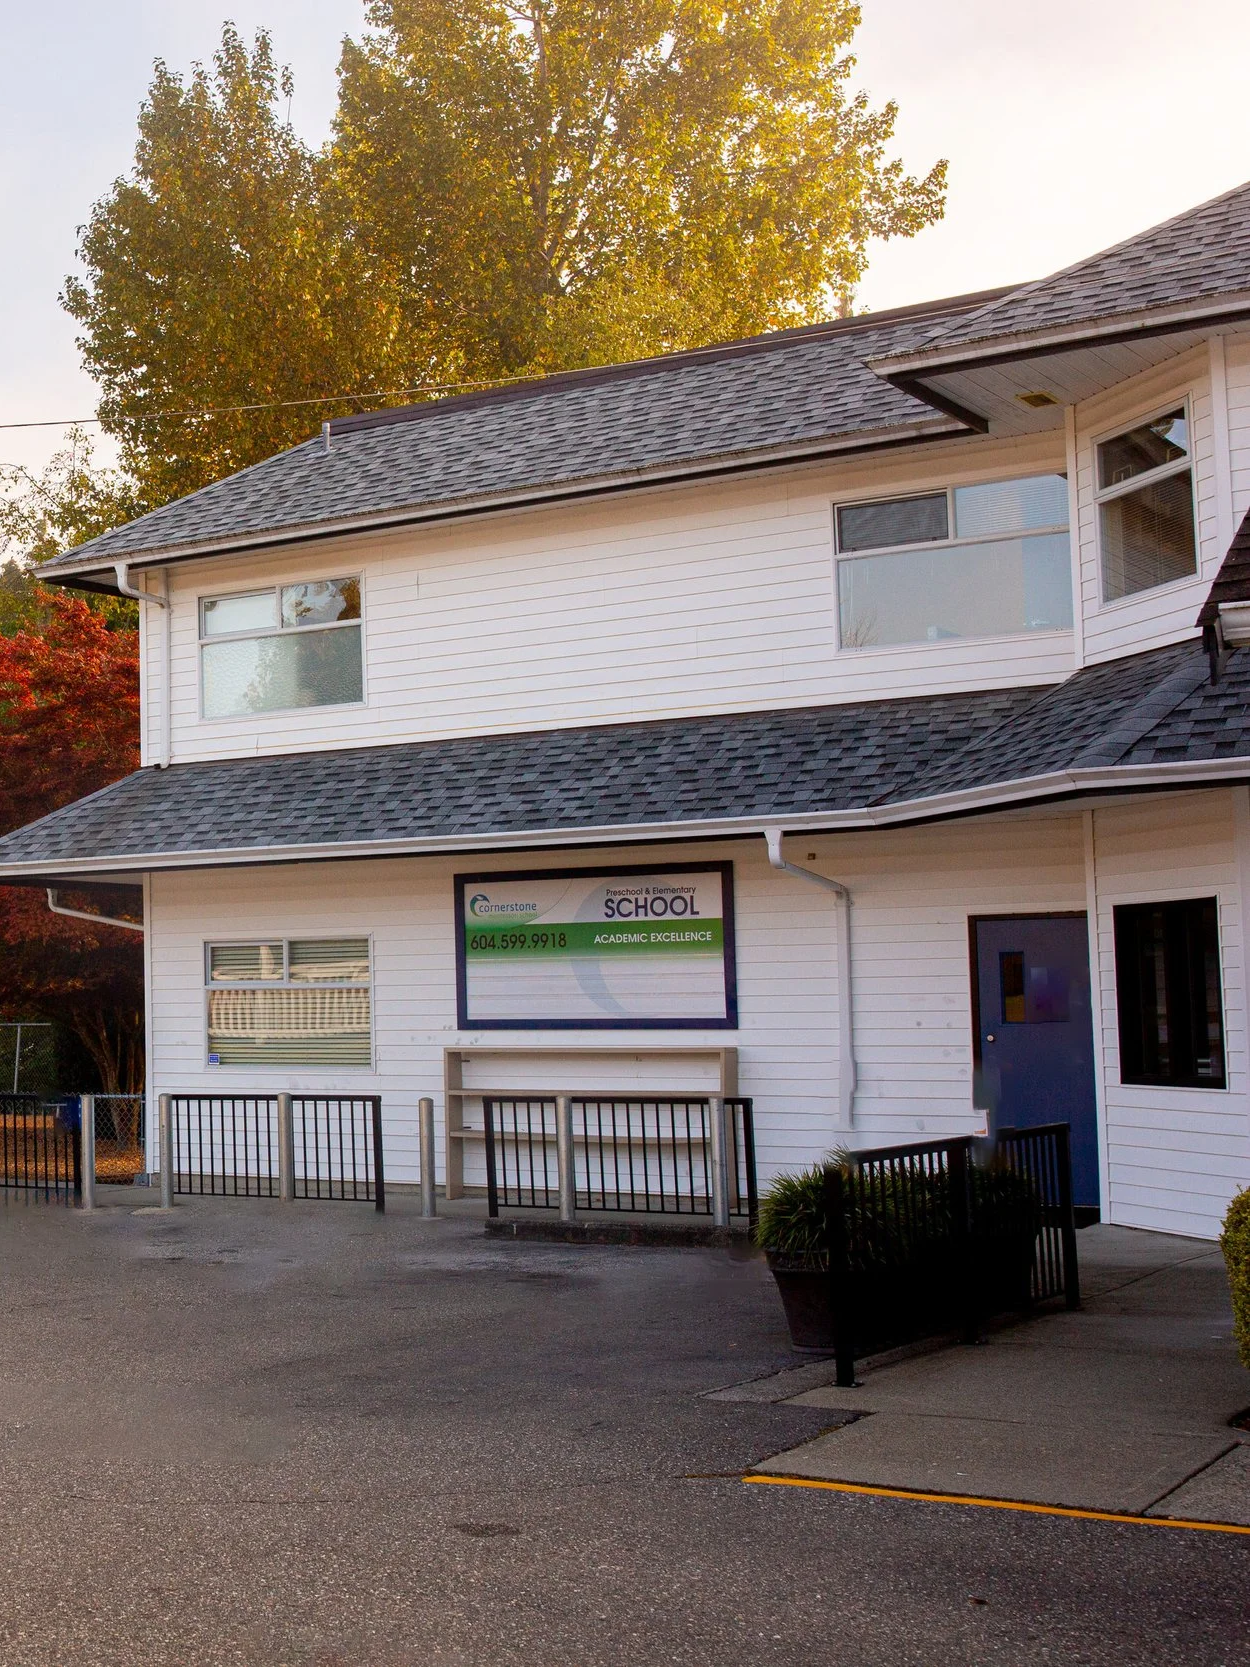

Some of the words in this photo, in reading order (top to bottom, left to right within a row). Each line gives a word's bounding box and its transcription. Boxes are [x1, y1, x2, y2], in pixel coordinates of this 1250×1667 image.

[606, 888, 643, 896] Preschool
[652, 886, 697, 895] Elementary
[478, 902, 537, 913] cornerstone
[604, 895, 700, 918] SCHOOL
[470, 932, 567, 950] 604.599.9918
[593, 933, 648, 944] ACADEMIC
[650, 931, 712, 942] EXCELLENCE
